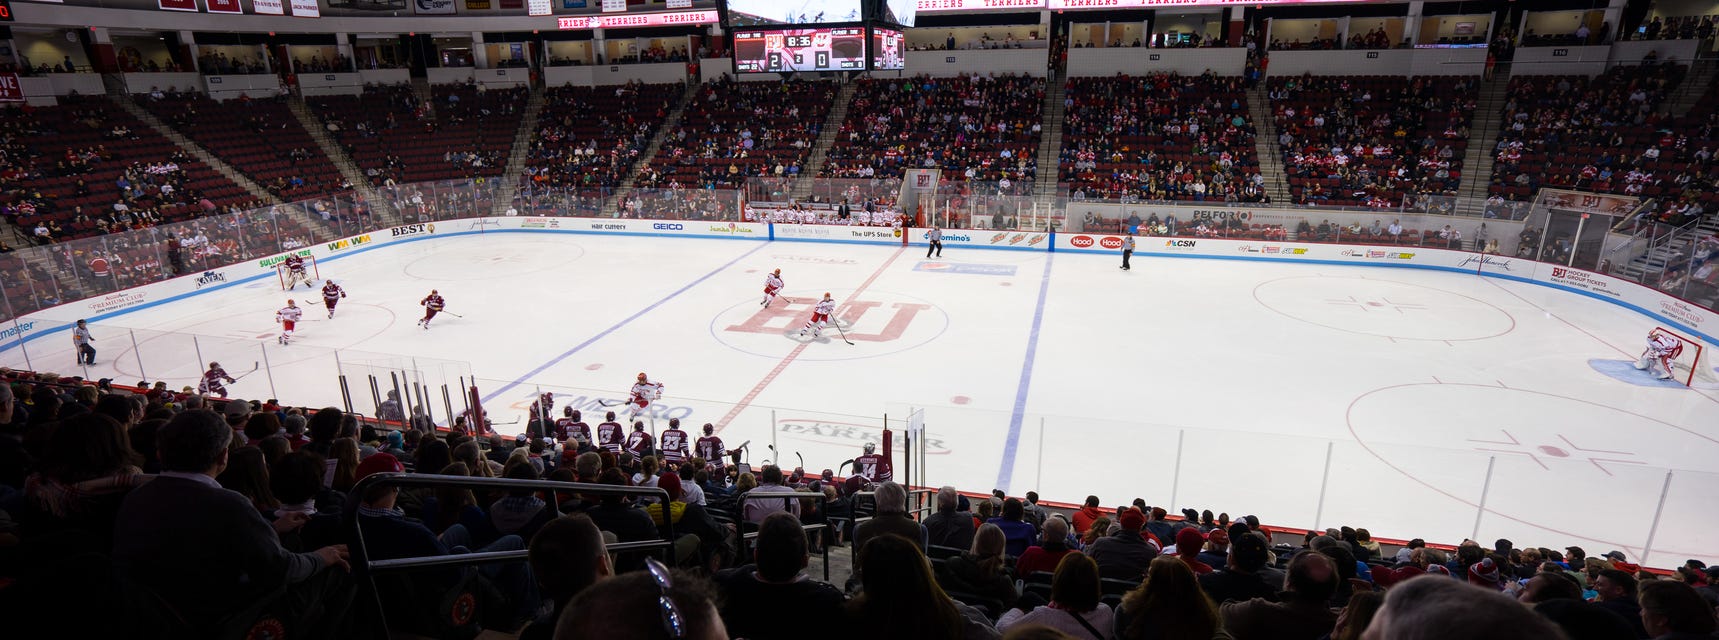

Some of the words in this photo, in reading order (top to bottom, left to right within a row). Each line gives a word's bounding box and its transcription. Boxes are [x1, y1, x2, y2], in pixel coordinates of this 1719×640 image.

[606, 17, 648, 25] TERRIERS
[663, 14, 706, 22] TERRIERS
[771, 55, 778, 67] 2
[818, 53, 825, 66] 0
[0, 76, 17, 89] VE
[1582, 196, 1602, 208] BU
[391, 223, 425, 237] BEST
[653, 223, 683, 231] GEICO
[940, 234, 971, 242] omino's
[1072, 237, 1092, 246] Hood
[1102, 239, 1122, 247] Hood
[1176, 240, 1196, 248] CSN
[297, 249, 311, 258] TIRE
[1551, 267, 1567, 279] BU
[1568, 270, 1590, 278] HOCKEY
[1567, 274, 1586, 283] GROUP
[1586, 279, 1607, 288] TICKETS
[724, 297, 932, 343] BU
[0, 321, 34, 340] master
[663, 436, 682, 450] 23
